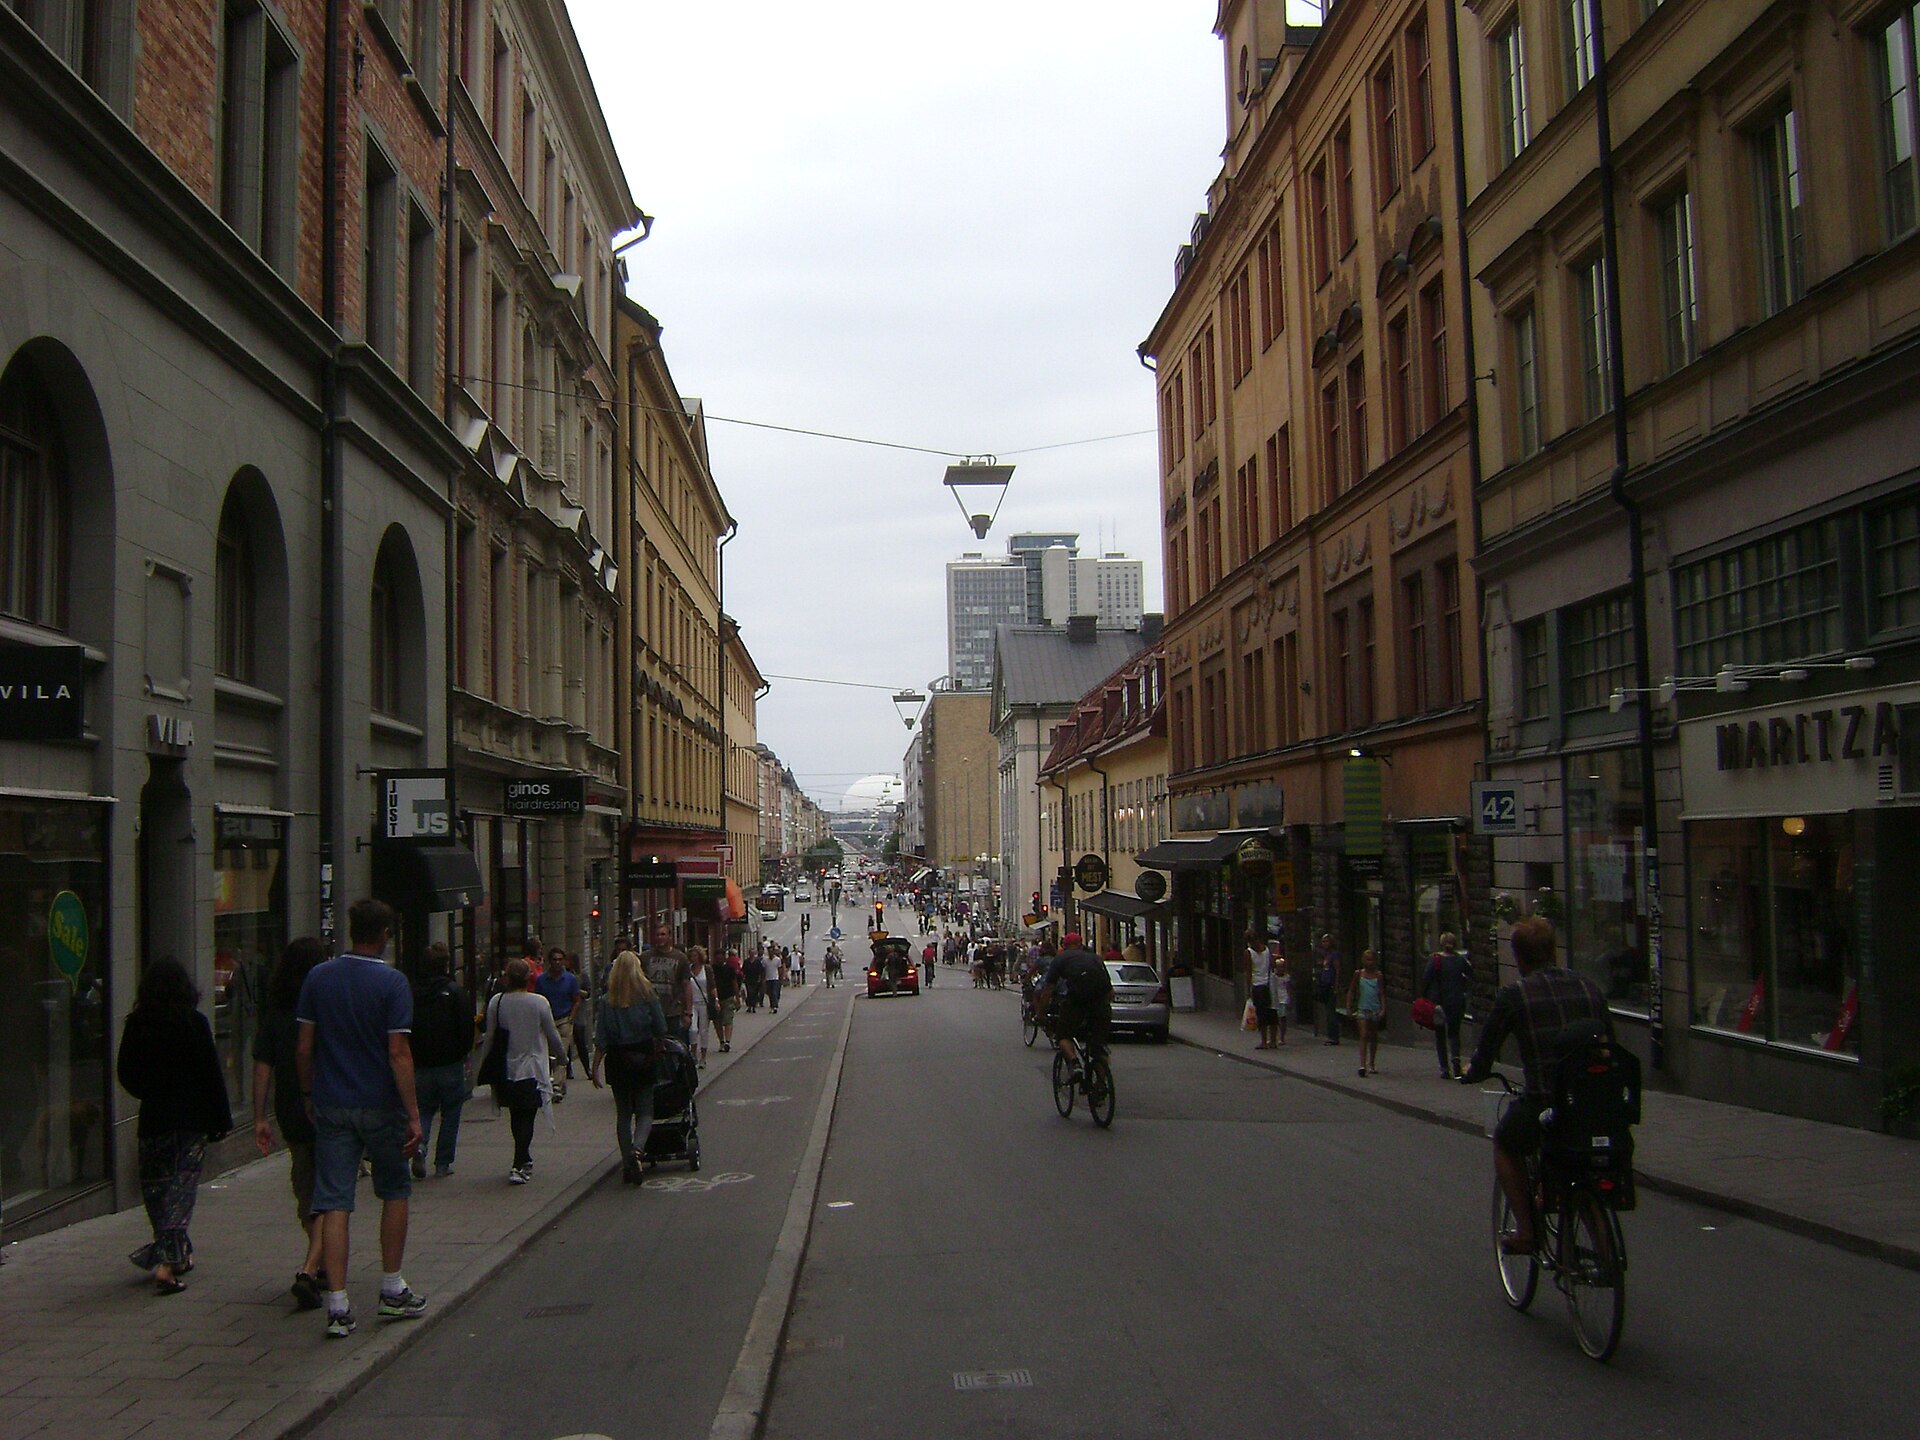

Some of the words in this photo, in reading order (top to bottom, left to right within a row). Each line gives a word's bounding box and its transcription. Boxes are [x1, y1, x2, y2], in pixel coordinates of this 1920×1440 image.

[0, 684, 72, 700] VILA
[155, 713, 194, 747] VILA
[1715, 701, 1898, 771] MARITZA
[507, 780, 552, 798] ginos
[389, 780, 398, 836] JUST
[507, 798, 580, 812] hairdressing
[1483, 796, 1515, 820] 42
[412, 811, 449, 835] US
[53, 910, 84, 958] Sale
